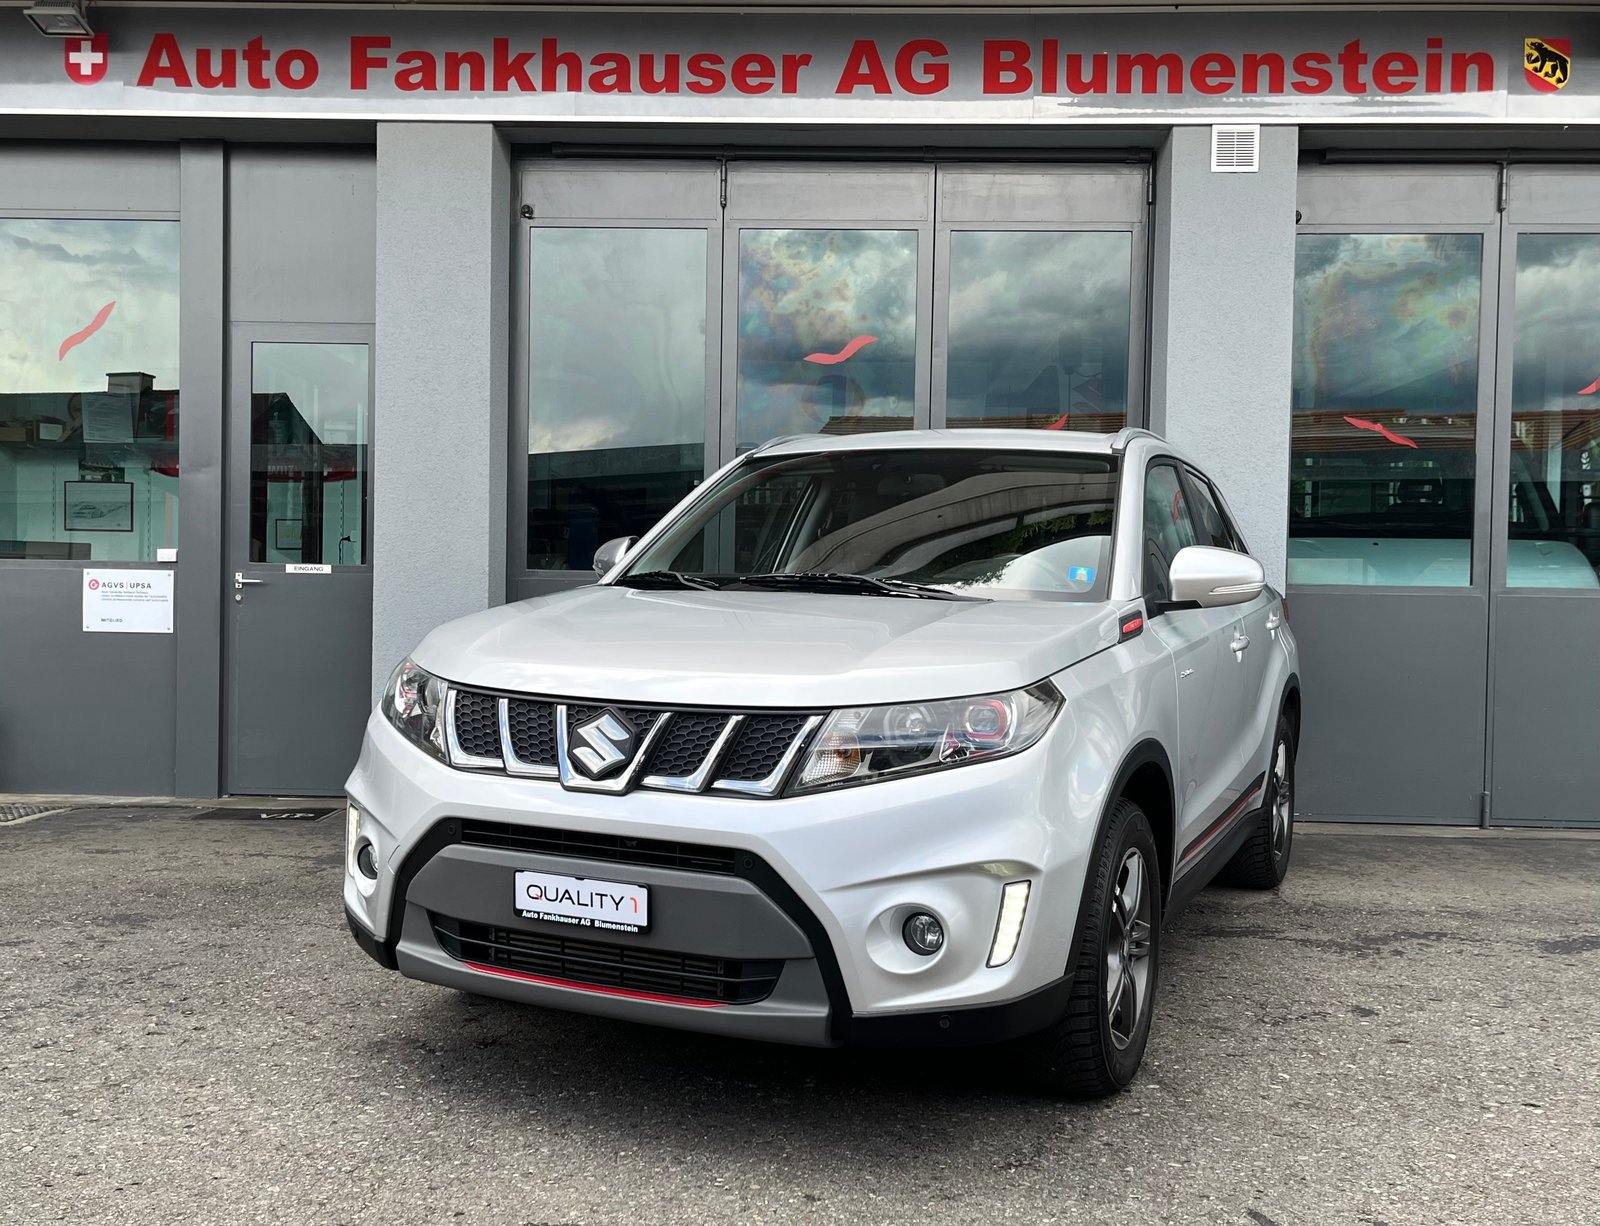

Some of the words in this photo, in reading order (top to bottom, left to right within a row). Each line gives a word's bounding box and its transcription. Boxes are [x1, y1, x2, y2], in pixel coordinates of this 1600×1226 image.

[136, 33, 320, 90] Auto
[350, 36, 813, 95] Fankhauser
[835, 39, 950, 96] AG
[982, 37, 1495, 96] Blumenstein
[526, 884, 625, 911] QUALITY
[522, 910, 538, 919] Auto
[539, 913, 579, 925] Fankhauser
[580, 918, 591, 927] AG
[594, 920, 638, 933] Blumenstein
